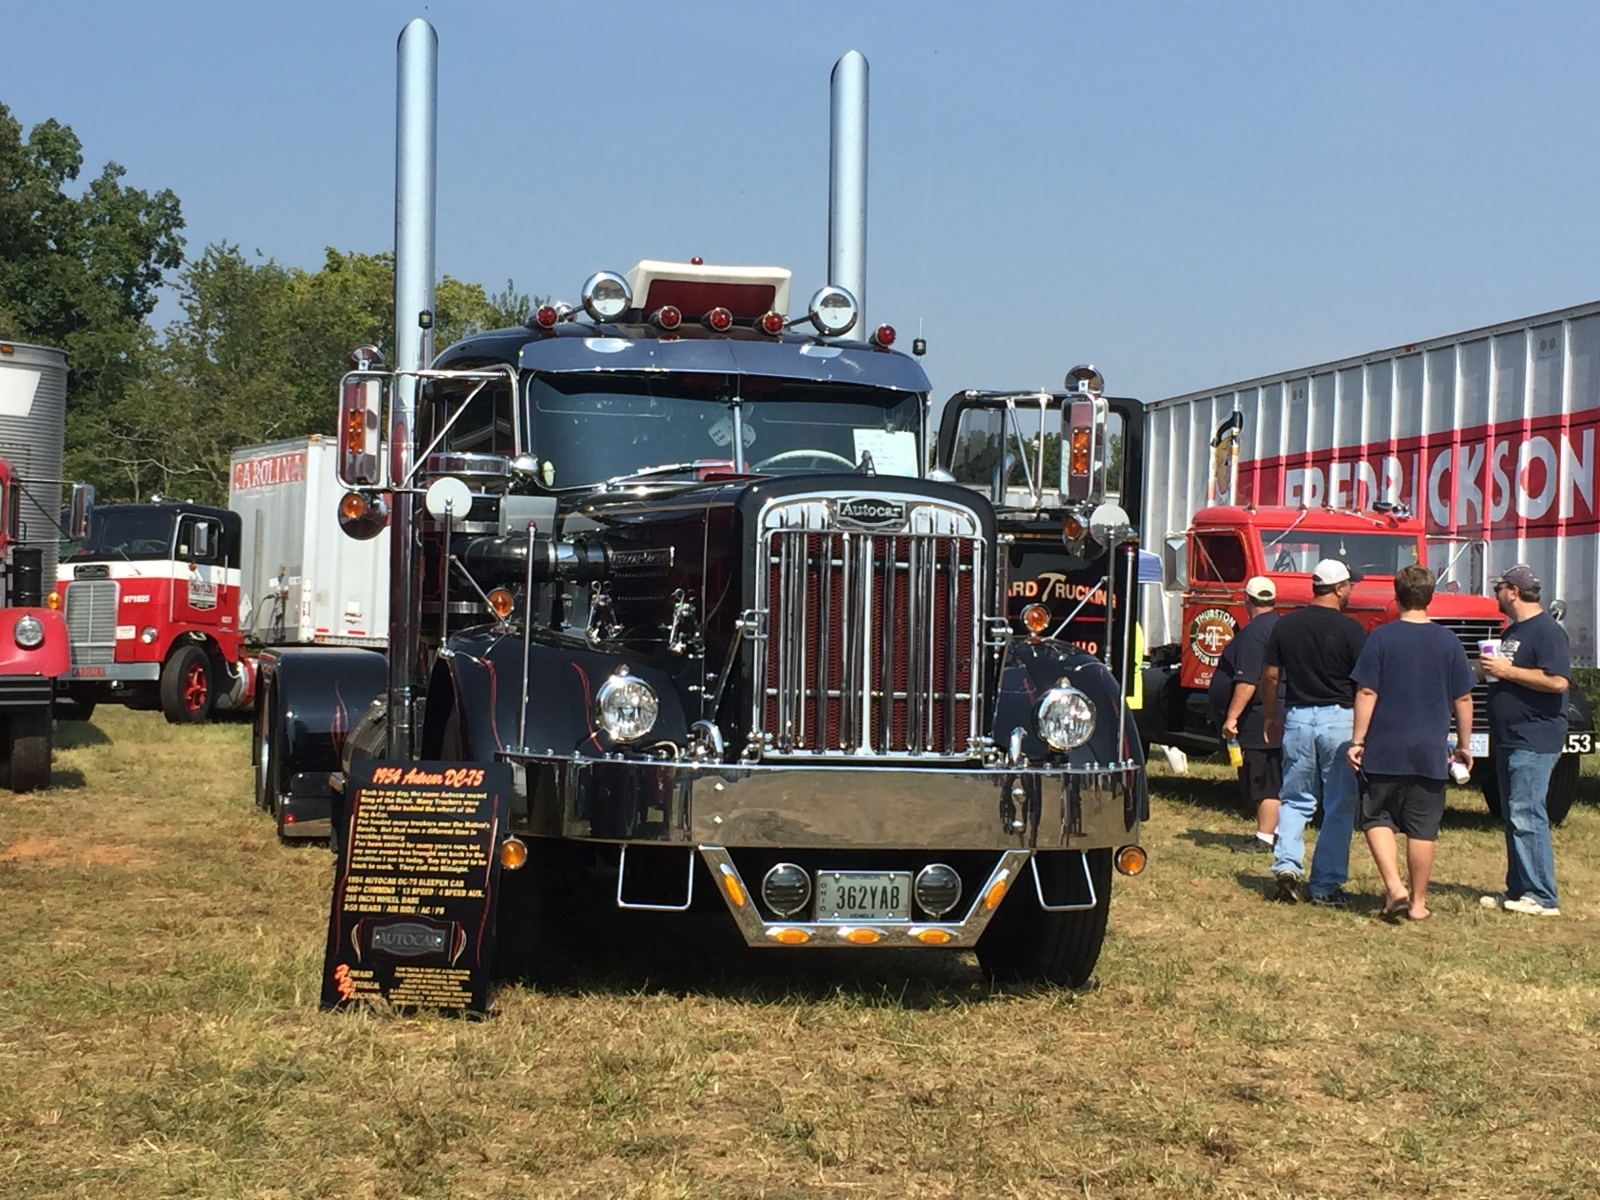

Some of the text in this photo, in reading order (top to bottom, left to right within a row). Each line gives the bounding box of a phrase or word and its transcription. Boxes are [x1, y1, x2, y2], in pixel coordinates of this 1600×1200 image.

[234, 455, 302, 490] CAROLINA
[1285, 427, 1596, 528] FREDRICKSON
[841, 503, 902, 518] Autocar
[1194, 608, 1237, 629] THURSTON
[371, 766, 402, 785] 1954
[364, 876, 397, 885] AUTOCAR
[418, 877, 449, 887] SLEEPER
[376, 895, 400, 904] WHEEL
[411, 887, 434, 896] SPEED
[836, 885, 901, 910] 362YAB
[377, 931, 441, 948] AUTOCAR
